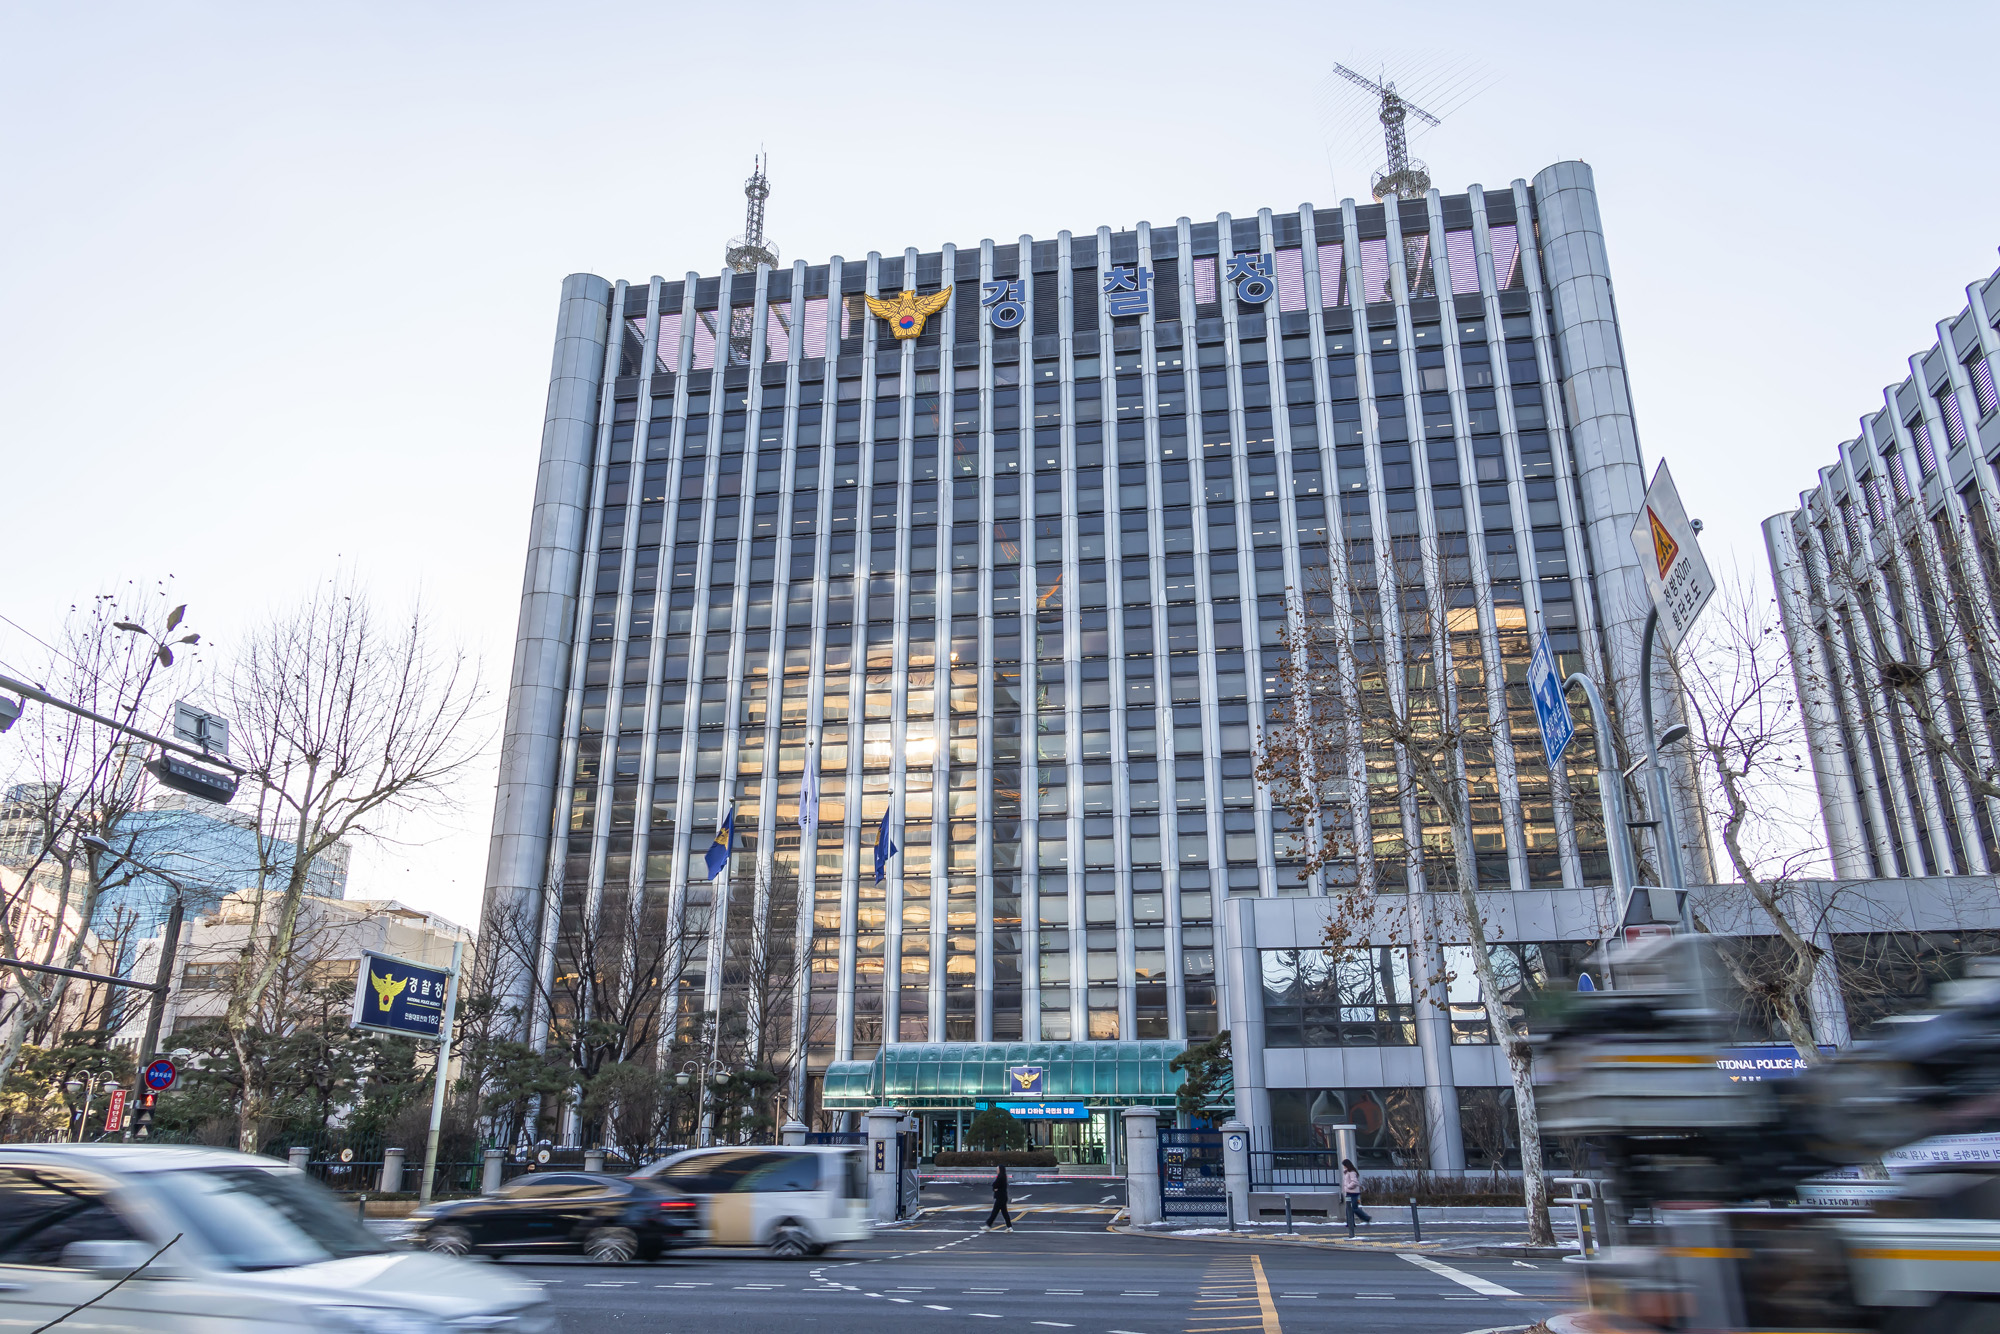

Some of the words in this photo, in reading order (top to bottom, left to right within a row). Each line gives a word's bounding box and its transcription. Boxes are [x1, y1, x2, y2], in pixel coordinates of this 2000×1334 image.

[982, 253, 1275, 329] 경찰청
[1663, 573, 1679, 608] 전방
[1674, 557, 1692, 587] 80m
[1672, 578, 1701, 632] 횡단보도
[409, 977, 443, 998] 경찰청
[428, 1015, 439, 1024] 182
[1756, 1059, 1793, 1069] POLICE
